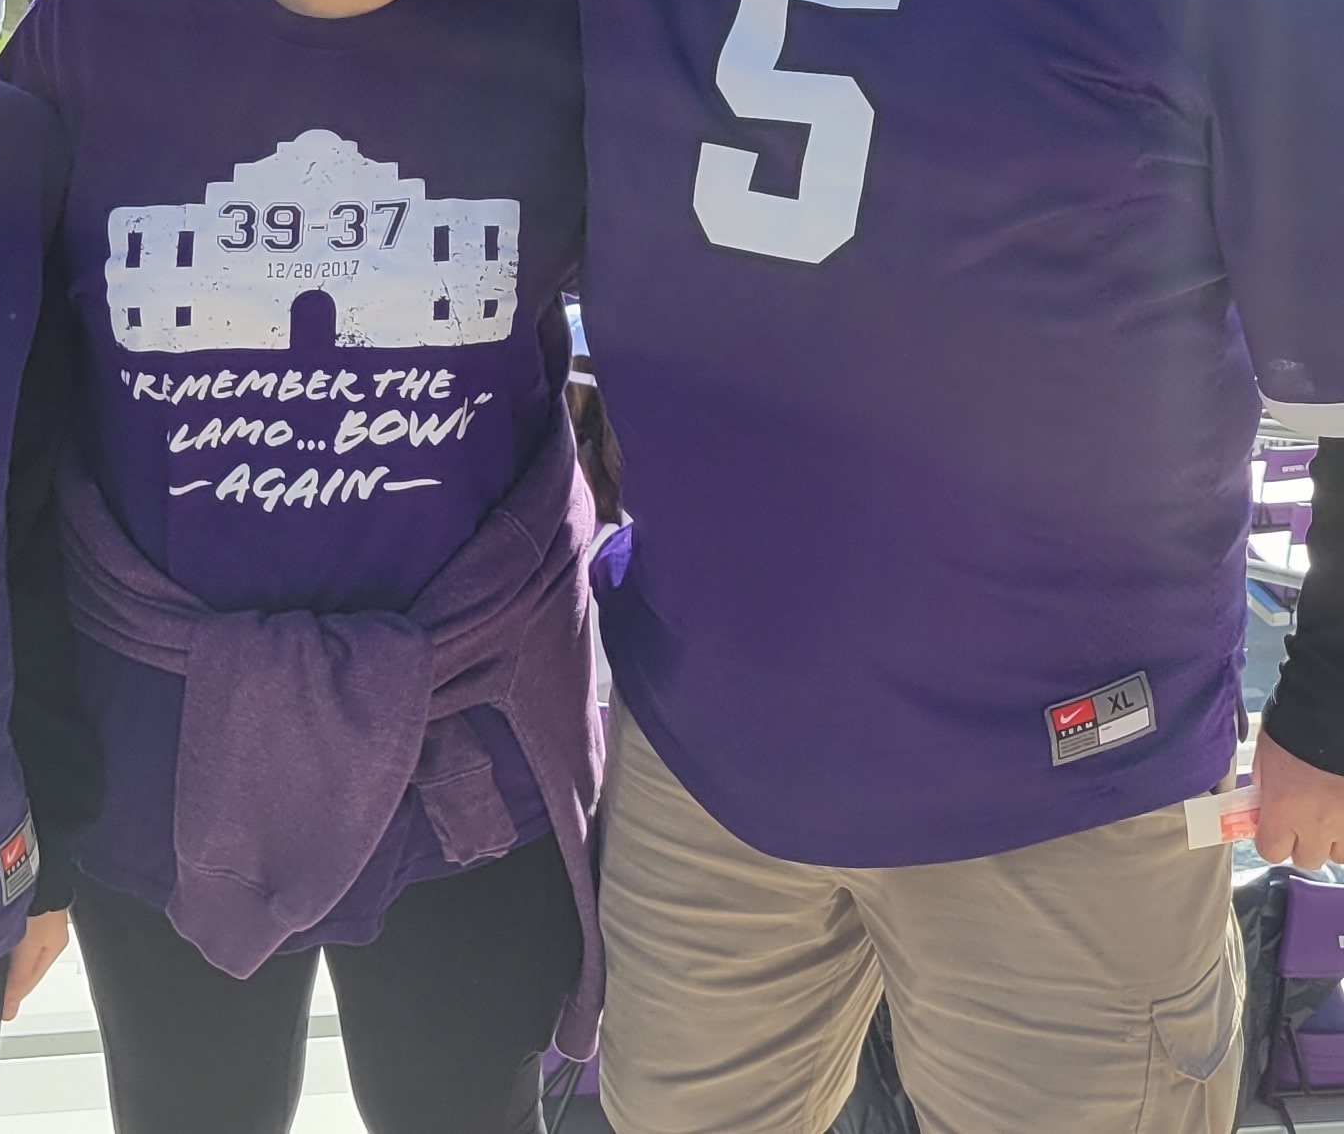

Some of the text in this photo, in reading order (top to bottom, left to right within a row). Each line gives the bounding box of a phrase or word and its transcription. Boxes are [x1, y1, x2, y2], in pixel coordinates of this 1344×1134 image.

[217, 200, 410, 252] 39-37
[267, 260, 360, 279] 12/28/2017
[373, 369, 456, 400] THE
[1107, 690, 1135, 715] XL
[1060, 721, 1094, 738] TEAM
